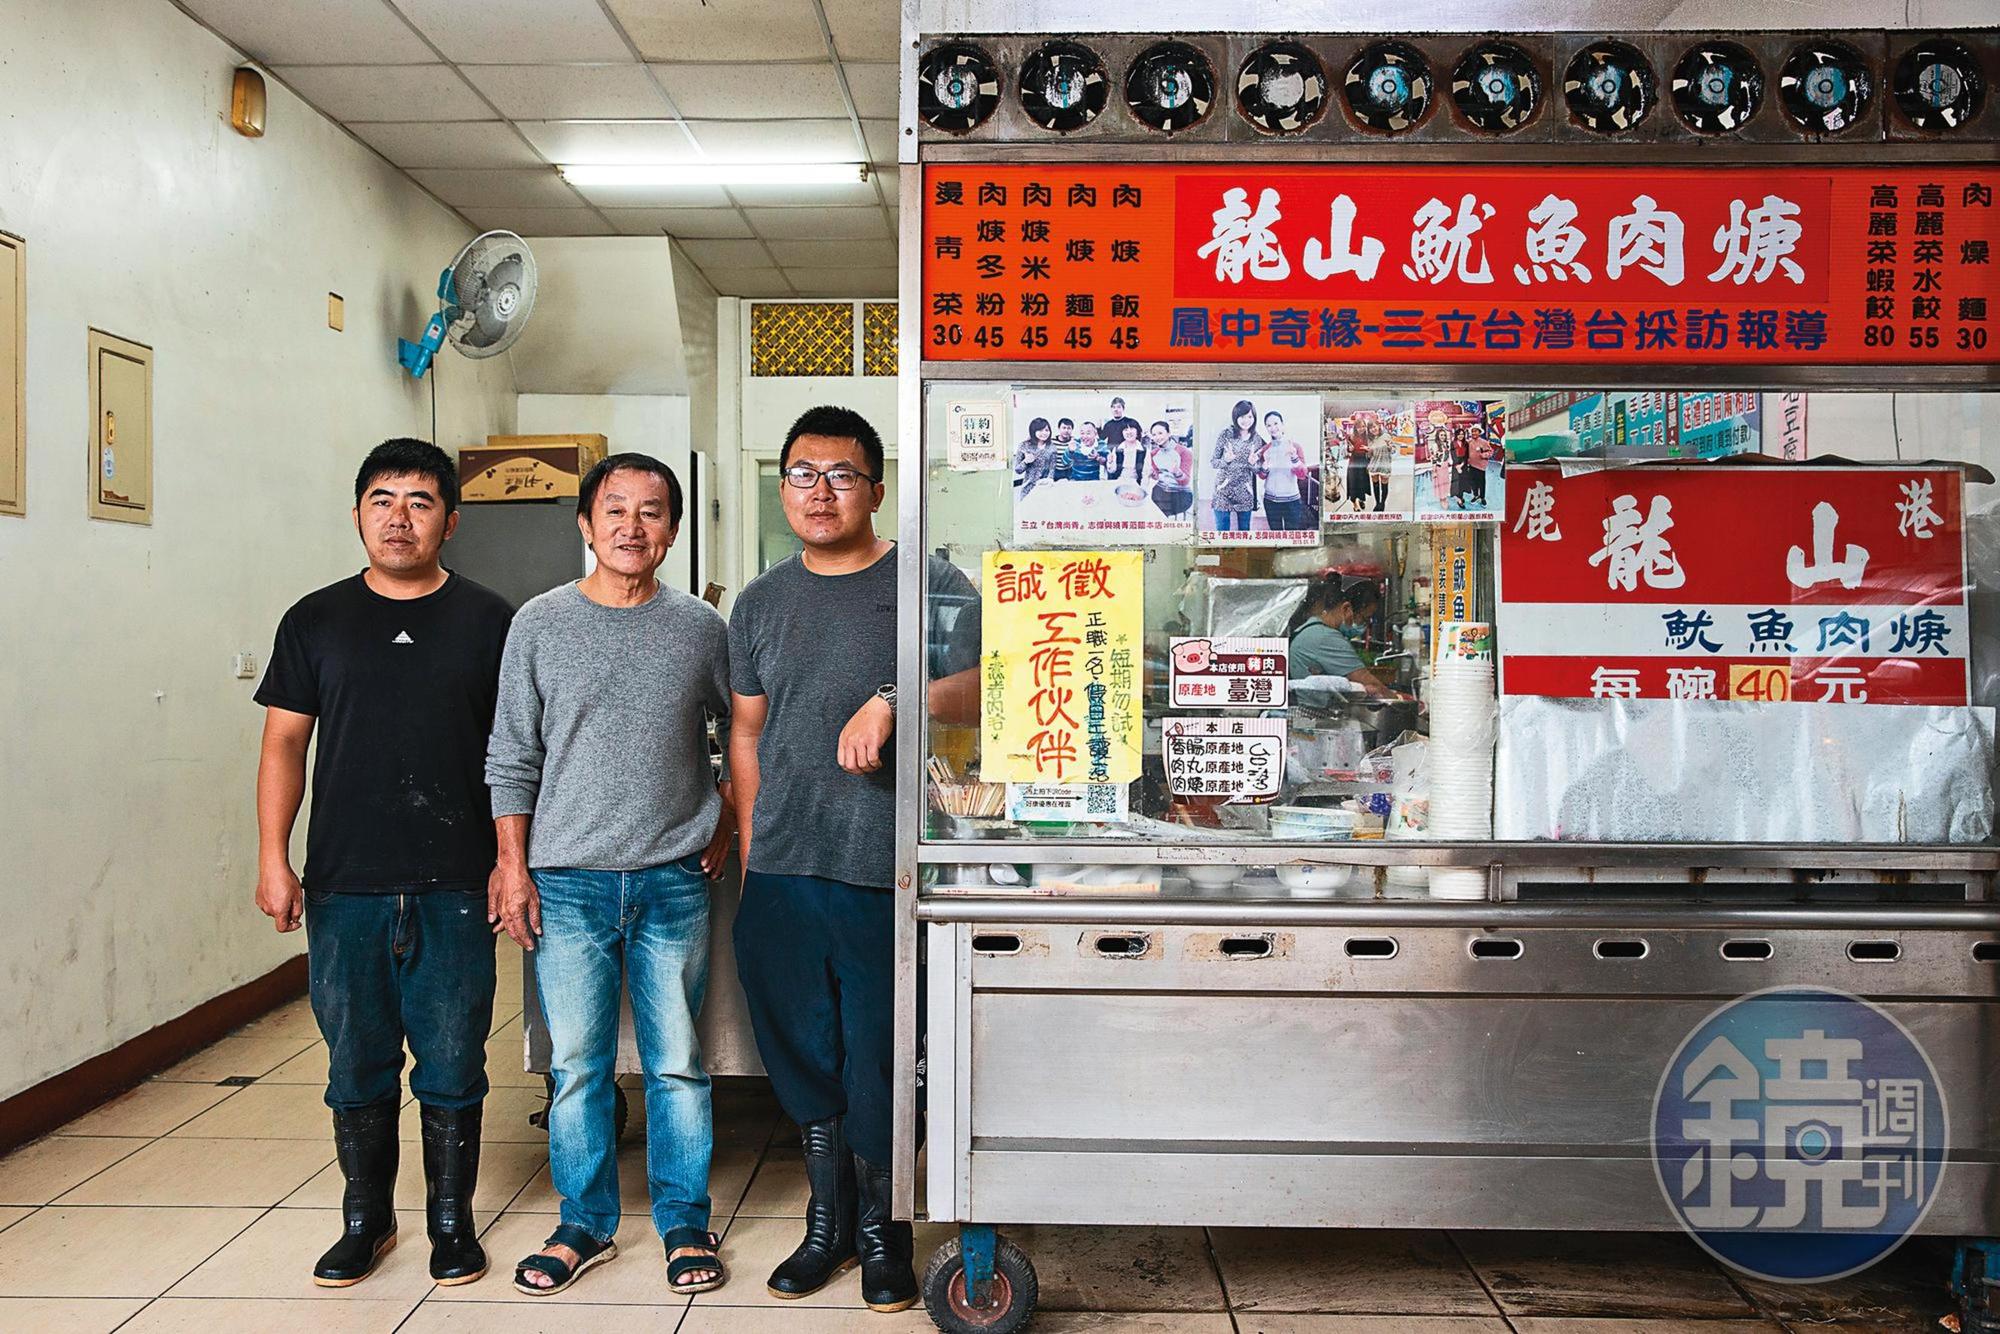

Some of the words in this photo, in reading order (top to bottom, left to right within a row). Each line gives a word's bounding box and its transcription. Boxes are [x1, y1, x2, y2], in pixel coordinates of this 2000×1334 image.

[1866, 184, 1899, 320] 高麗菜蝦餃
[1911, 182, 1946, 320] 高麗菜水餃
[1957, 182, 1993, 322] 肉燥麵
[933, 324, 963, 346] 30
[974, 325, 1004, 348] 45
[1020, 326, 1049, 349] 45
[1064, 326, 1092, 349] 45
[1109, 326, 1140, 350] 45
[1864, 324, 1896, 347] 80
[1909, 326, 1940, 348] 55
[1956, 327, 1988, 350] 30
[1512, 479, 1562, 542] 鹿
[1588, 494, 1870, 591] 龍山
[1895, 478, 1945, 539] 港
[994, 558, 1116, 604] 誠徵
[1026, 611, 1082, 779] 工作伙伴
[1109, 648, 1135, 734] 短期勿試
[1178, 683, 1216, 697] 原產地
[1228, 677, 1273, 703] 臺灣
[1206, 721, 1244, 734] 本店
[1170, 757, 1244, 775] 肉丸原產地
